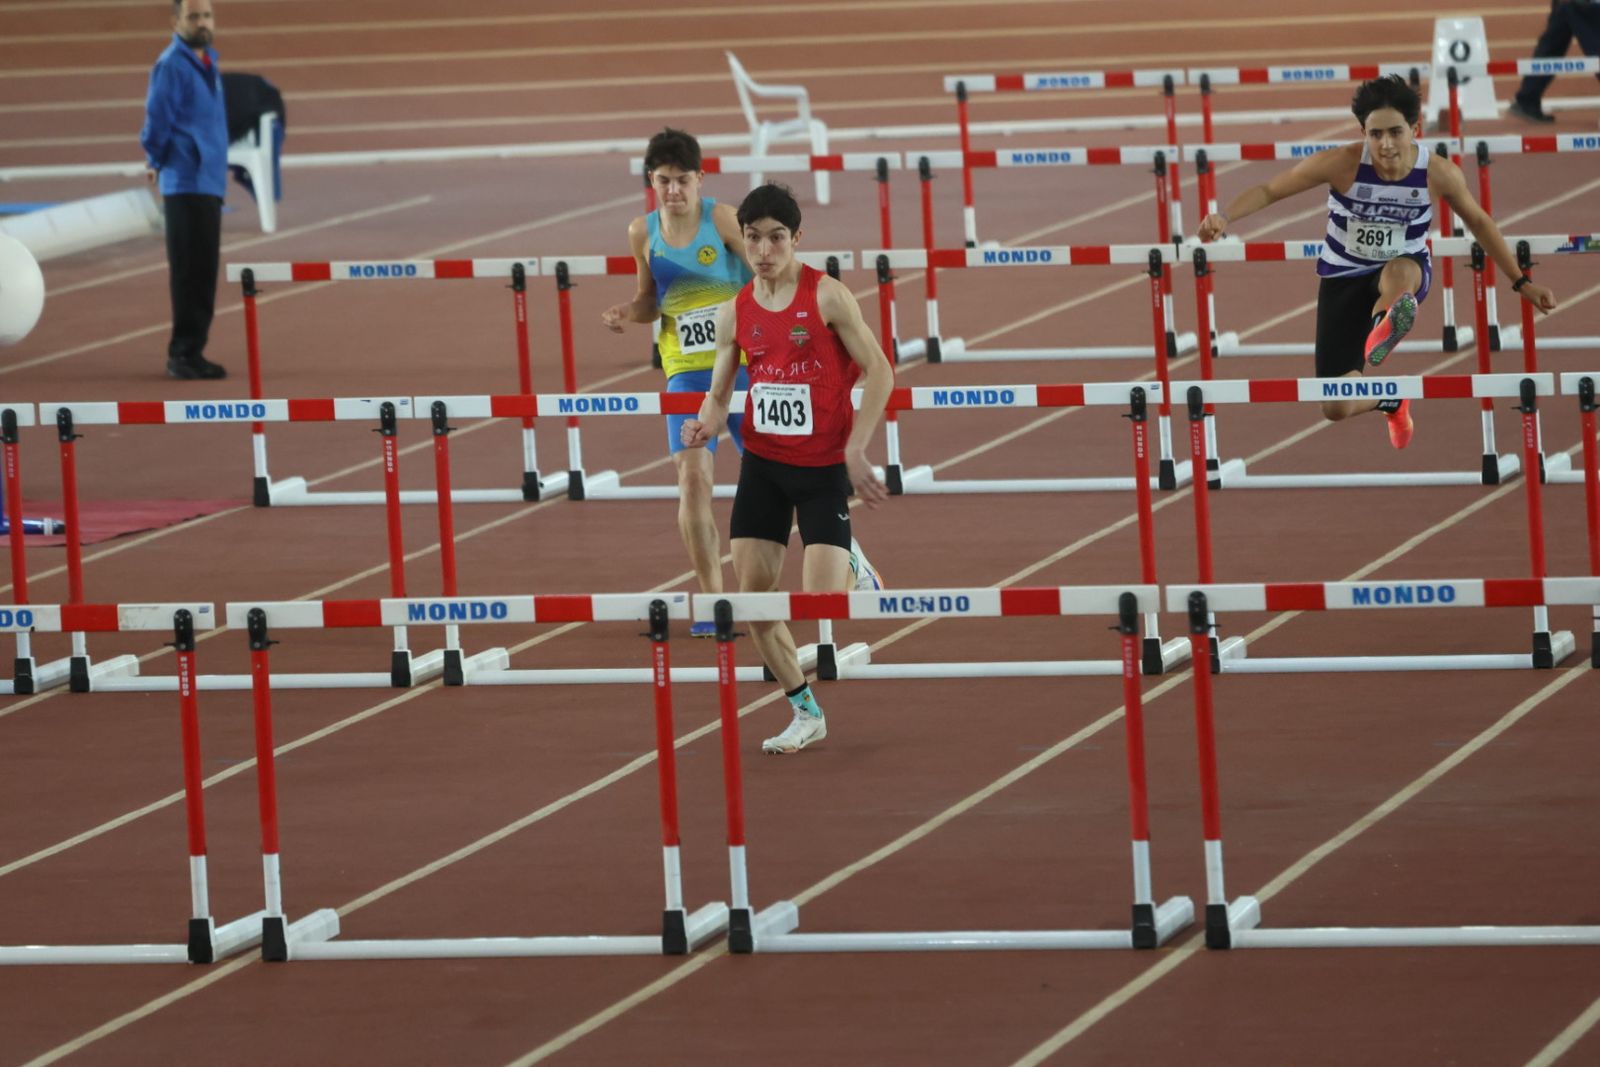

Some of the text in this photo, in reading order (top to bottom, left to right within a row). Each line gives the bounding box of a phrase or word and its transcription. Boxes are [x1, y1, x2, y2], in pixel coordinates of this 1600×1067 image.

[1282, 69, 1335, 80] MONDO
[1531, 62, 1585, 72] MONDO
[1037, 76, 1090, 88] MONDO
[1572, 137, 1600, 149] MO
[1011, 151, 1072, 164] MONDO
[1356, 229, 1393, 247] 2691
[983, 250, 1051, 263] MONDO
[349, 265, 416, 277] MONDO
[1322, 380, 1398, 396] MONDO
[557, 395, 639, 413] MONDO
[931, 388, 1014, 405] MONDO
[185, 402, 267, 420] MONDO
[757, 398, 806, 427] 1403
[1351, 584, 1456, 606] MONDO
[408, 601, 508, 621] MONDO
[879, 595, 970, 613] MONDO
